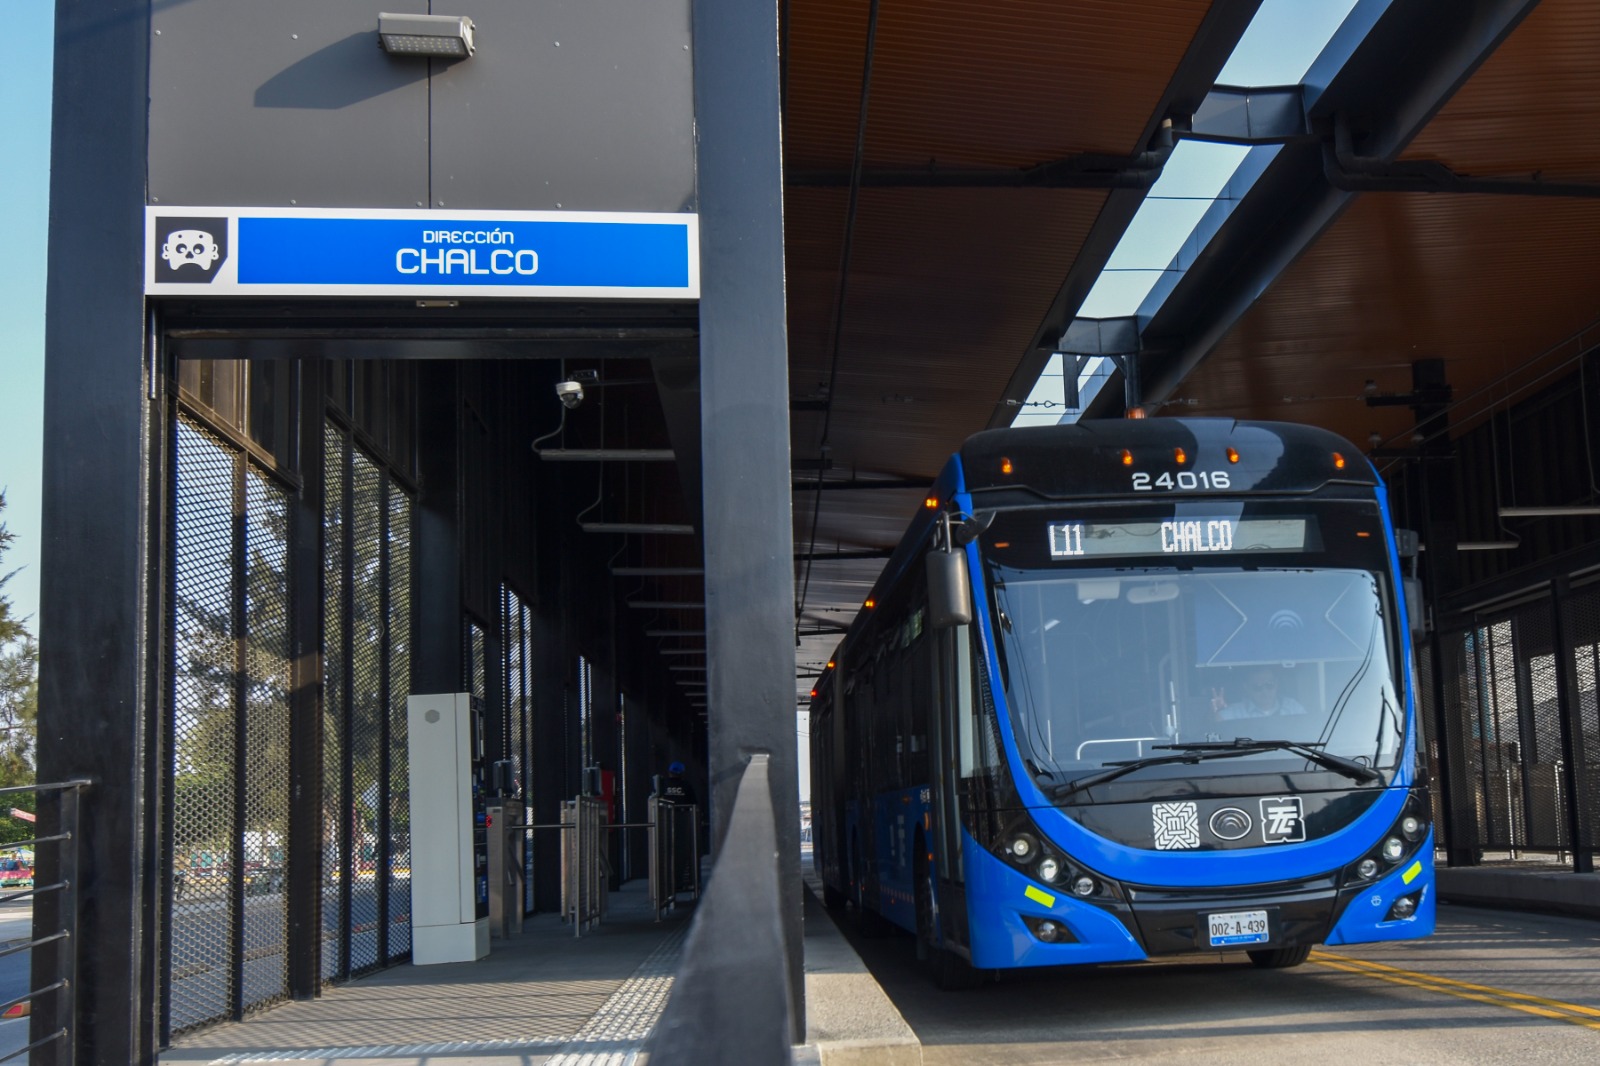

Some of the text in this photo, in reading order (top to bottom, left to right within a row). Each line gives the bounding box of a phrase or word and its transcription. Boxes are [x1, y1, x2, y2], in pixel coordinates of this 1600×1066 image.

[423, 228, 514, 244] DIRECCIÓN
[396, 248, 539, 275] CHALCO
[1132, 471, 1231, 490] 24016
[1049, 520, 1232, 555] L11 CHALCO
[1211, 920, 1266, 936] 002-A-439
